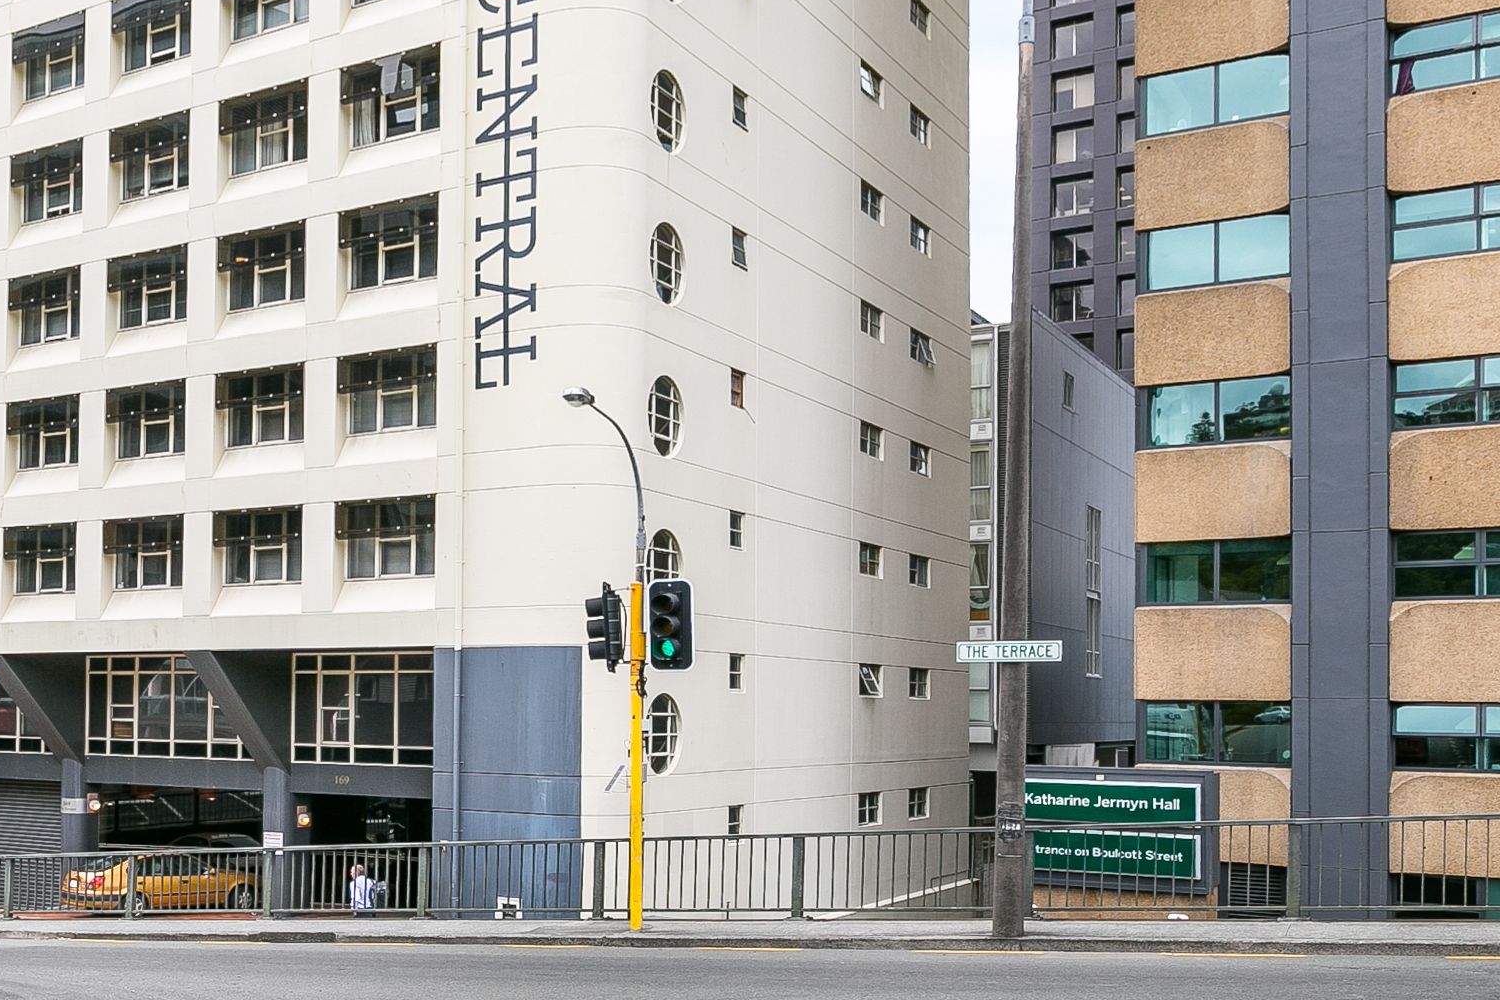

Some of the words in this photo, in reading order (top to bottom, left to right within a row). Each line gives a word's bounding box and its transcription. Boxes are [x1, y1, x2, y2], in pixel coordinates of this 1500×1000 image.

[966, 645, 989, 658] THE
[996, 645, 1053, 658] TERRACE
[334, 775, 350, 785] 169
[1025, 792, 1090, 807] Katharine
[1093, 795, 1148, 812] Jermyn
[1152, 797, 1181, 811] Hall
[1074, 848, 1090, 857] on
[1092, 847, 1142, 860] Boulcott
[1145, 850, 1183, 863] Street
